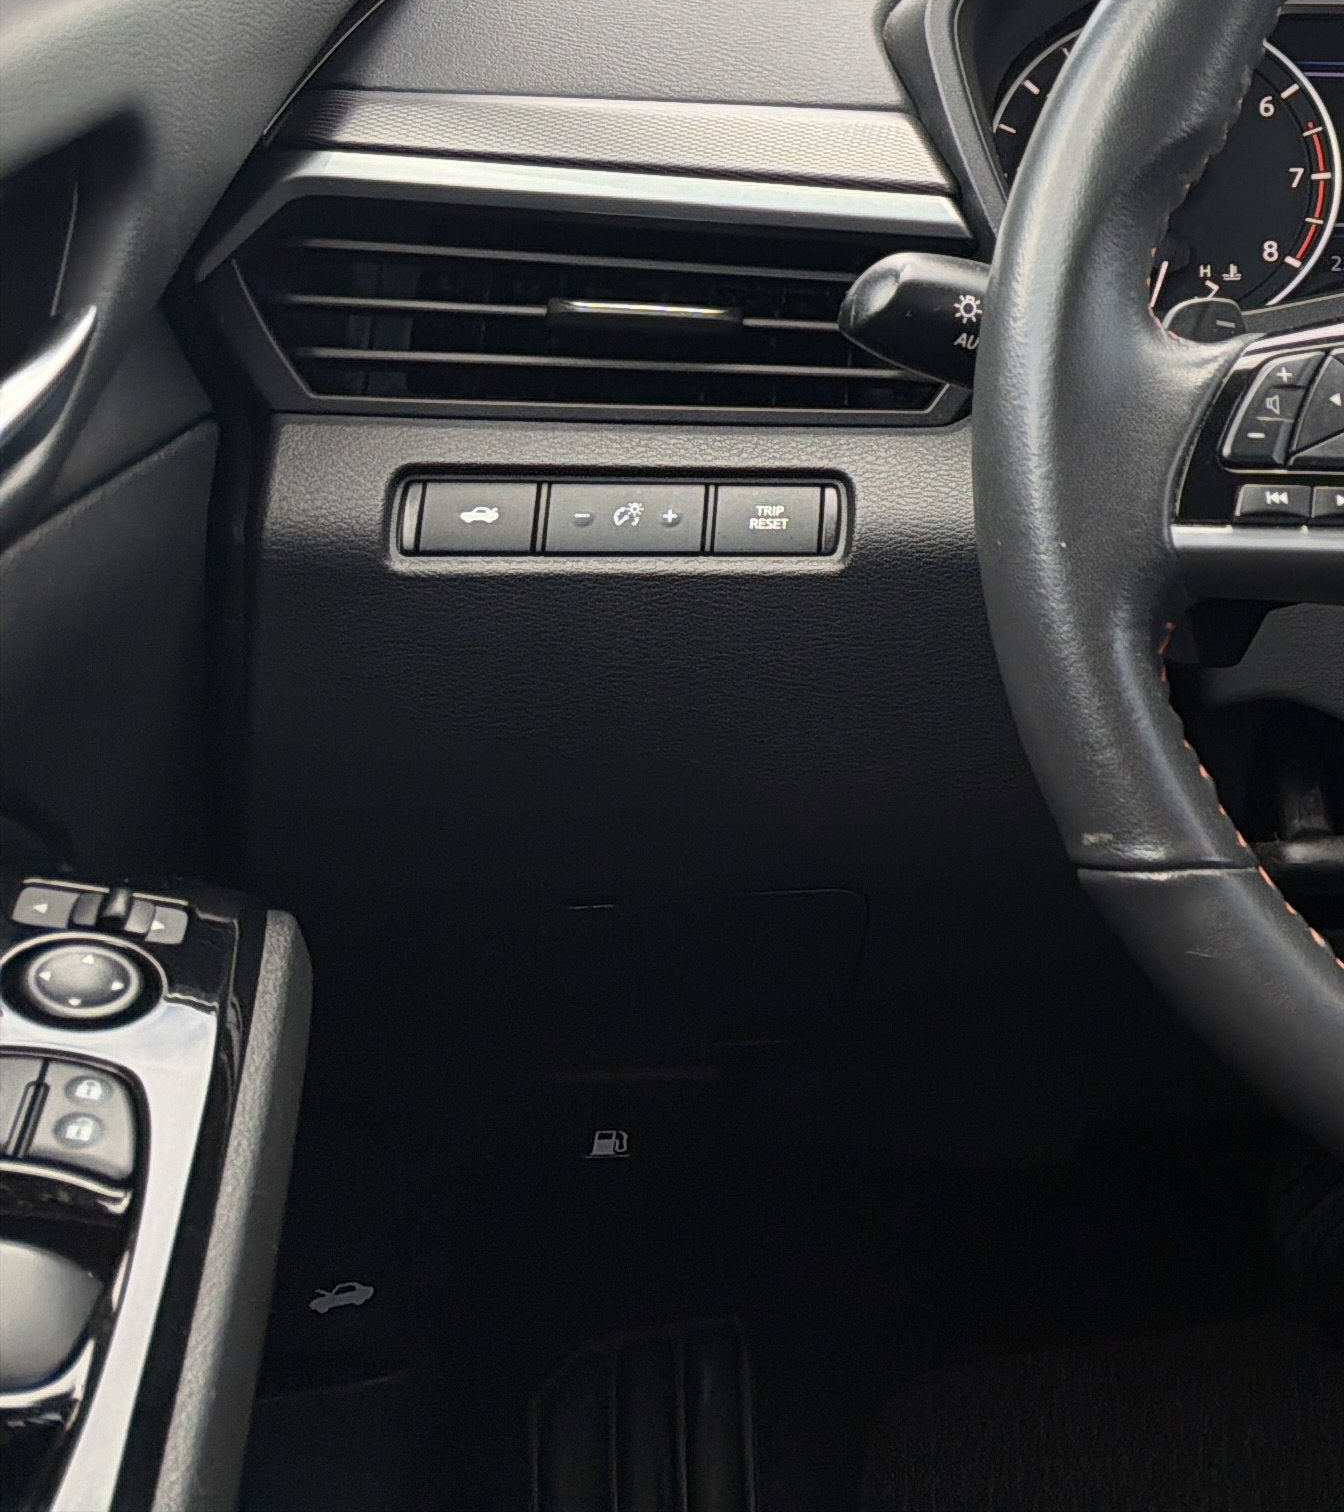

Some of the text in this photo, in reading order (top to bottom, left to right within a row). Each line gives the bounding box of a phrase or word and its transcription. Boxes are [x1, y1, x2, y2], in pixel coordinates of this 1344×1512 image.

[1259, 96, 1275, 117] 6
[1289, 167, 1305, 189] 7
[1262, 240, 1279, 263] 8
[1199, 263, 1212, 278] H
[953, 332, 980, 350] AU
[755, 505, 785, 516] TRIP
[749, 518, 788, 530] RESET
